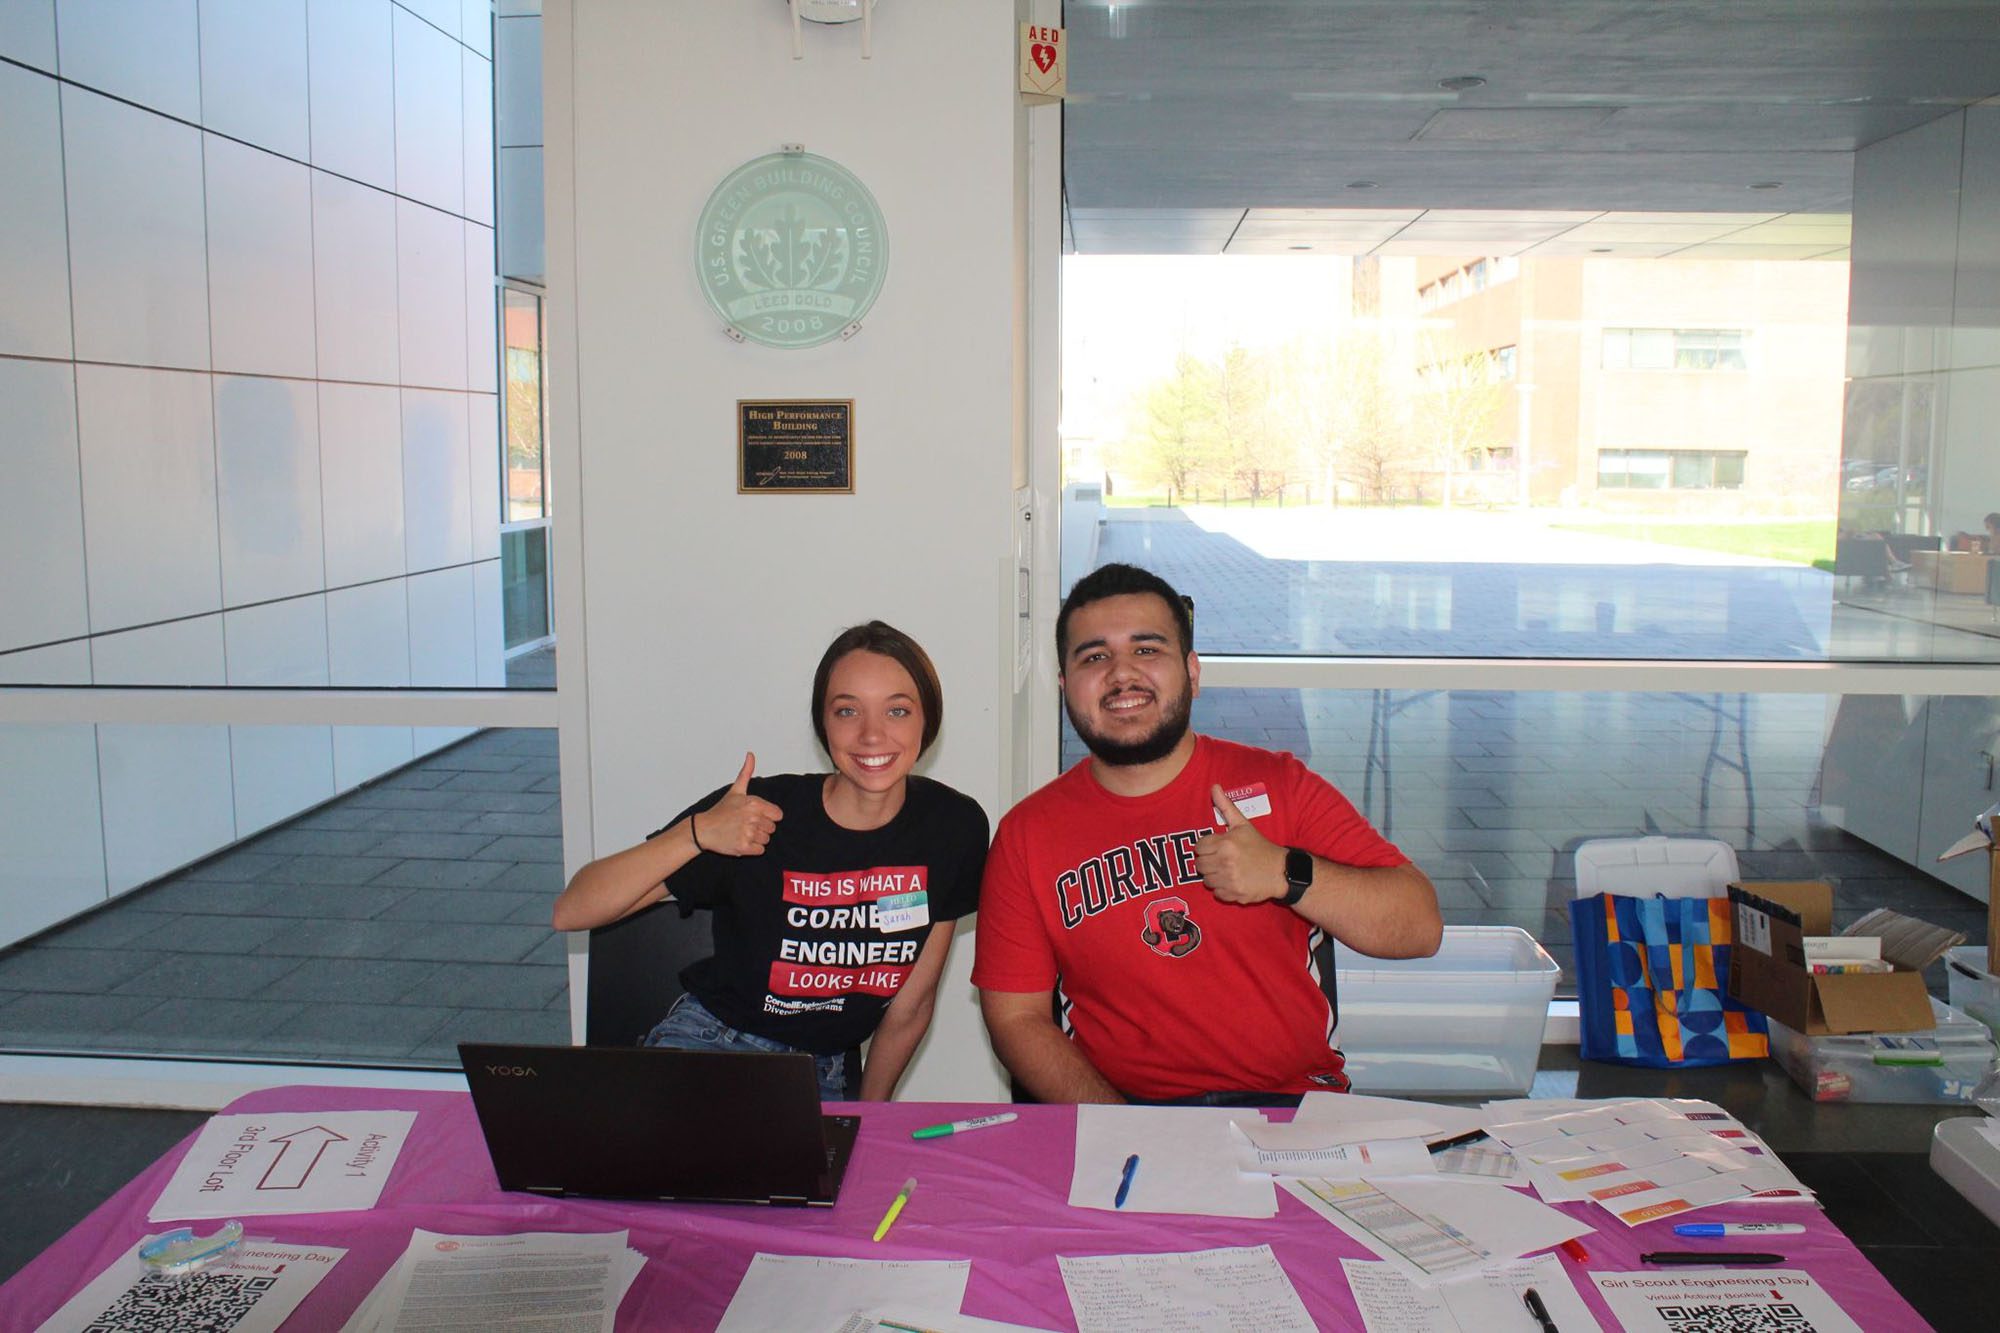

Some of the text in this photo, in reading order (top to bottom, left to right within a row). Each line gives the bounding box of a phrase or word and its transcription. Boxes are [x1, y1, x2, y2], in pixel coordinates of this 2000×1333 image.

[1029, 26, 1059, 43] AED
[712, 187, 751, 246] GREEN
[754, 168, 845, 200] BUILDING
[845, 202, 873, 284] COUNCIL
[755, 294, 832, 310] LEED GOLD
[761, 316, 824, 334] 2008
[784, 451, 807, 460] 2008
[790, 874, 922, 897] THIS IS WHAT A
[1056, 827, 1215, 929] CORNE
[787, 904, 881, 929] CORNE
[779, 938, 918, 966] ENGINEER
[788, 971, 901, 989] LOOKS LIKE
[485, 1065, 538, 1077] YOGA
[199, 1126, 267, 1193] 3rd Floor Loft
[346, 1132, 388, 1169] Activity
[241, 1249, 335, 1264] ineering Day
[1601, 1276, 1810, 1289] Girl Scout Engineering Day
[1647, 1291, 1765, 1301] Virtual Activity Booklet
